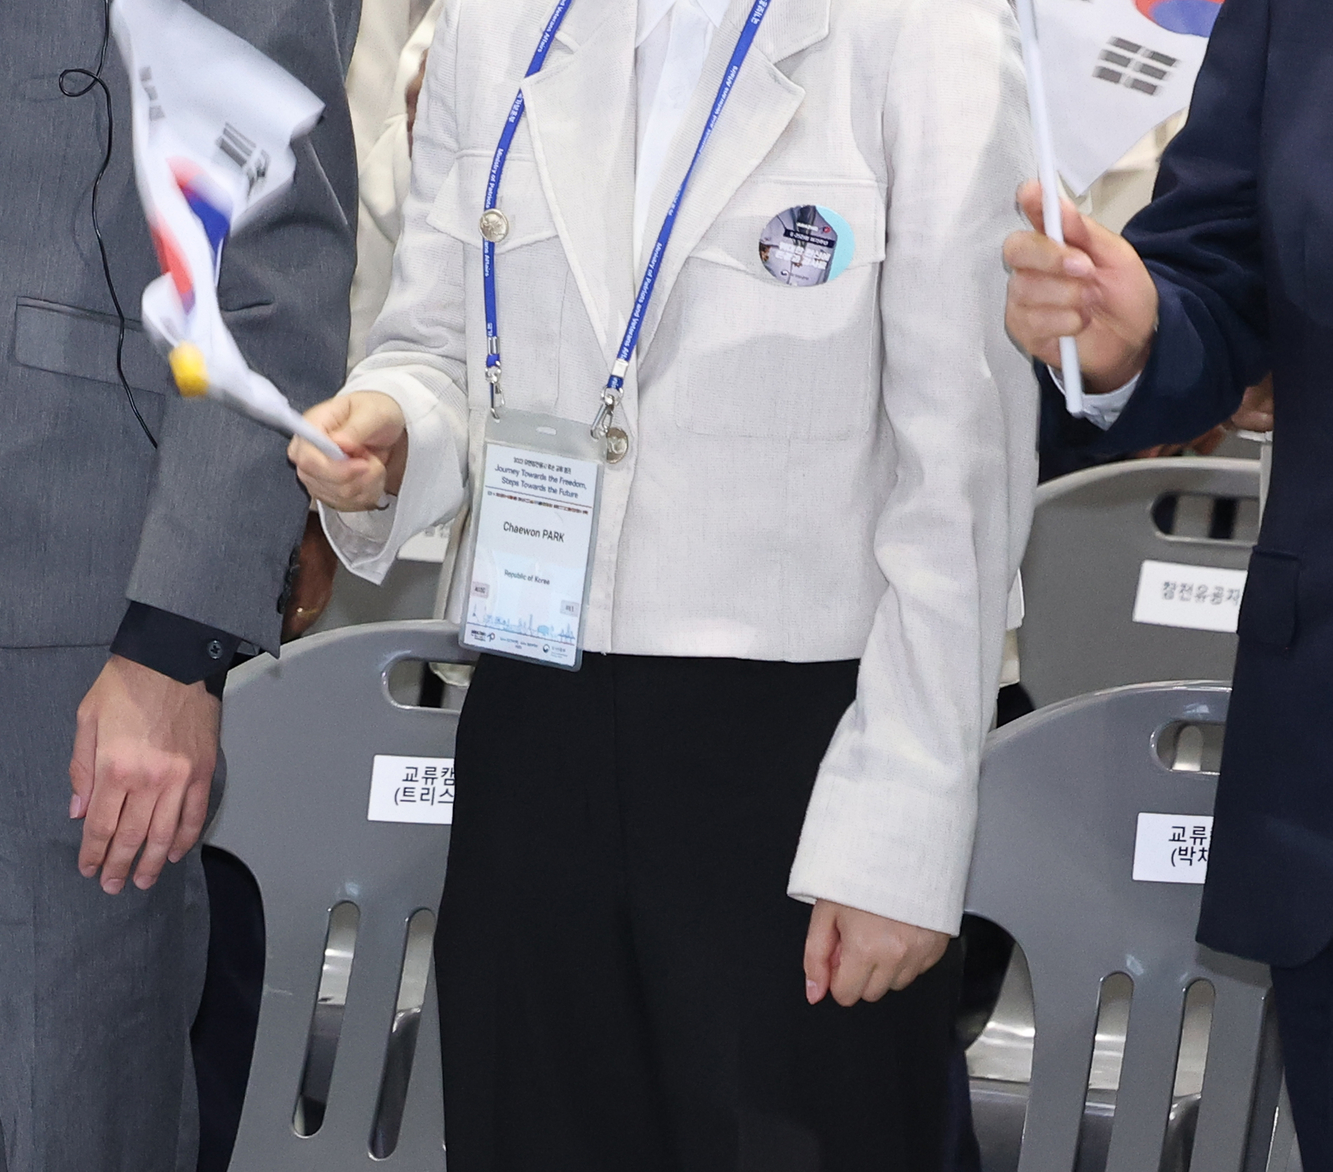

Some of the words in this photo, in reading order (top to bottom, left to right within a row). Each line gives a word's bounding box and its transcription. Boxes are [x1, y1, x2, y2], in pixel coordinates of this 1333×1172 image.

[537, 32, 549, 53] Affairs
[725, 65, 738, 87] Affairs
[489, 148, 504, 174] Ministry
[485, 183, 495, 209] Patriots
[650, 242, 662, 269] Ministry
[638, 277, 651, 303] Patriots
[625, 318, 638, 347] Veterans
[494, 464, 520, 477] Journey
[521, 469, 547, 481] Towards
[548, 475, 558, 484] the
[559, 477, 587, 490] Freedom,
[501, 476, 519, 488] Steps
[521, 480, 546, 492] Towards
[548, 485, 558, 494] the
[559, 488, 579, 499] Future
[502, 521, 540, 540] Chaewon
[542, 528, 565, 544] PARK
[504, 569, 526, 581] Republic
[534, 576, 551, 586] Korea
[1163, 581, 1240, 606] 참전유공자
[1168, 826, 1212, 845] 교류
